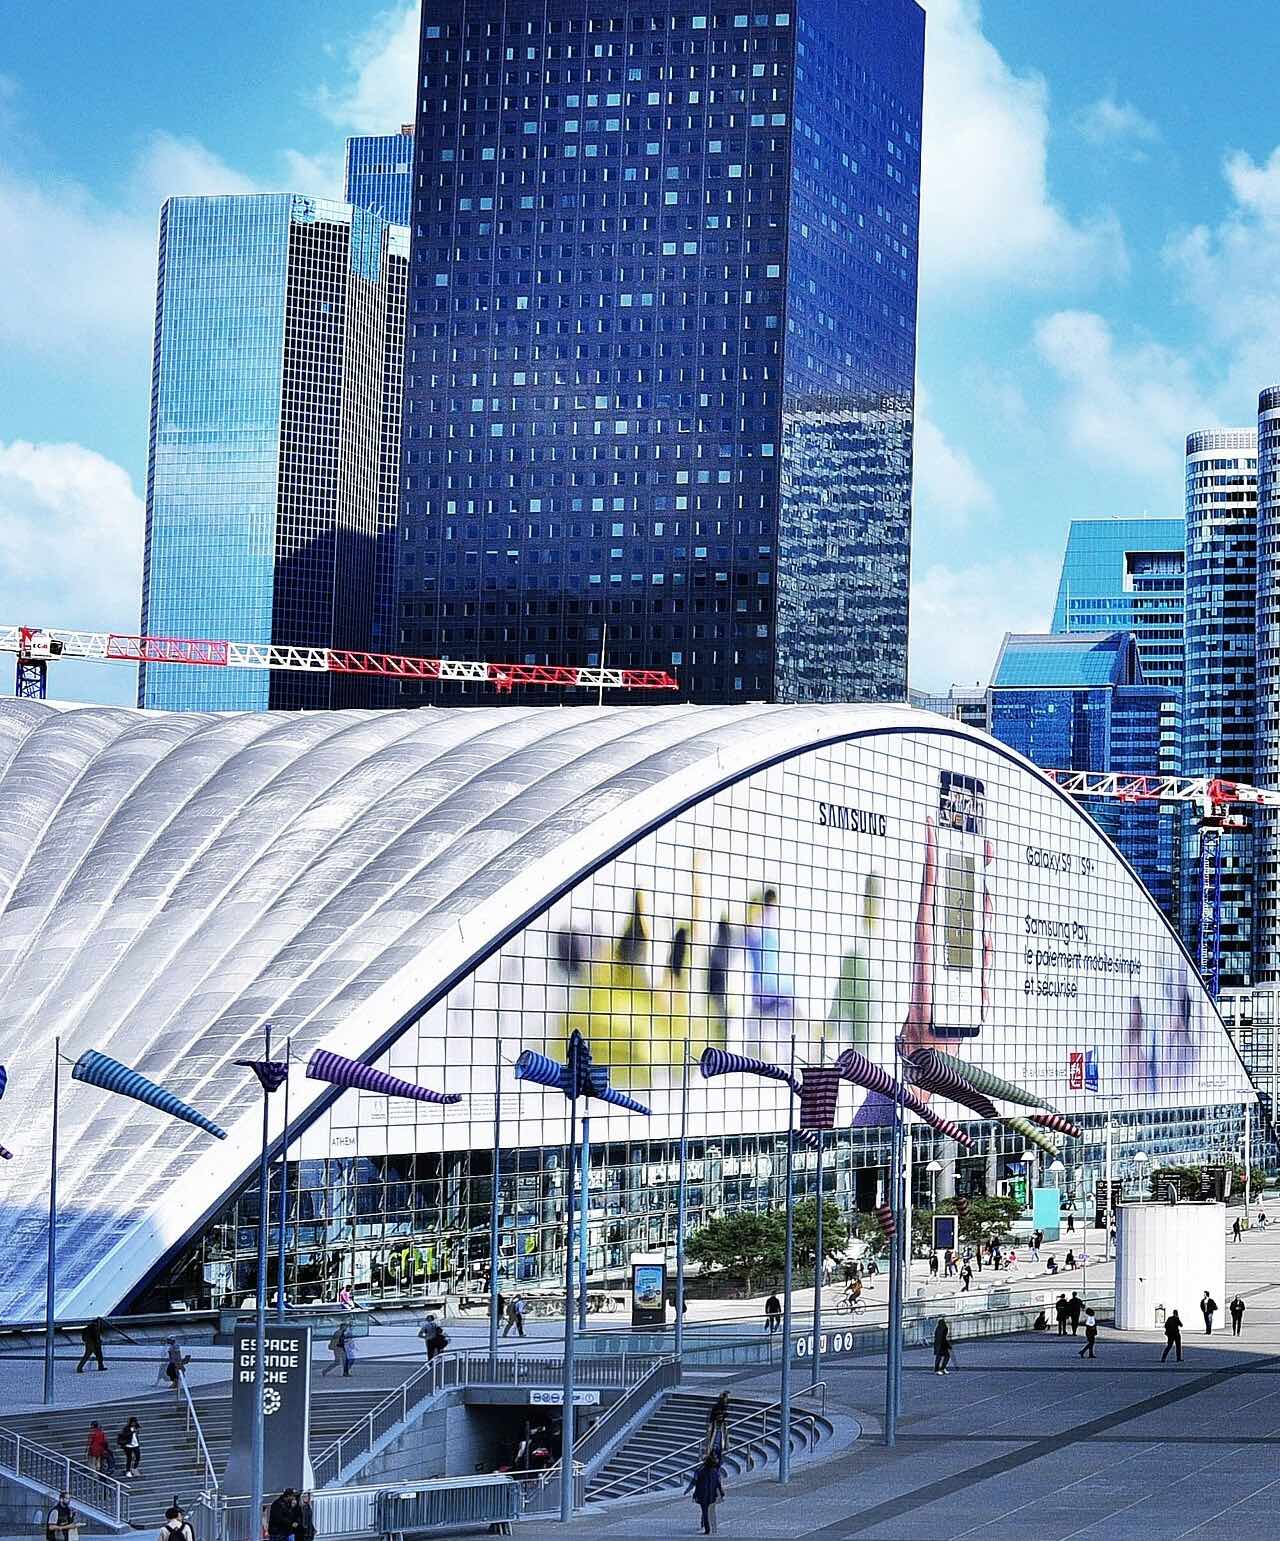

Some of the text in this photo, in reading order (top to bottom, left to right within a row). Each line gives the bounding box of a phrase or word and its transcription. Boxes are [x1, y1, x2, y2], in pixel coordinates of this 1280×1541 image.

[819, 802, 887, 837] SAMSUNG
[1026, 845, 1060, 875] Galaxy
[1025, 915, 1070, 945] Samsung
[1036, 945, 1081, 975] paiement
[1025, 976, 1035, 995] et
